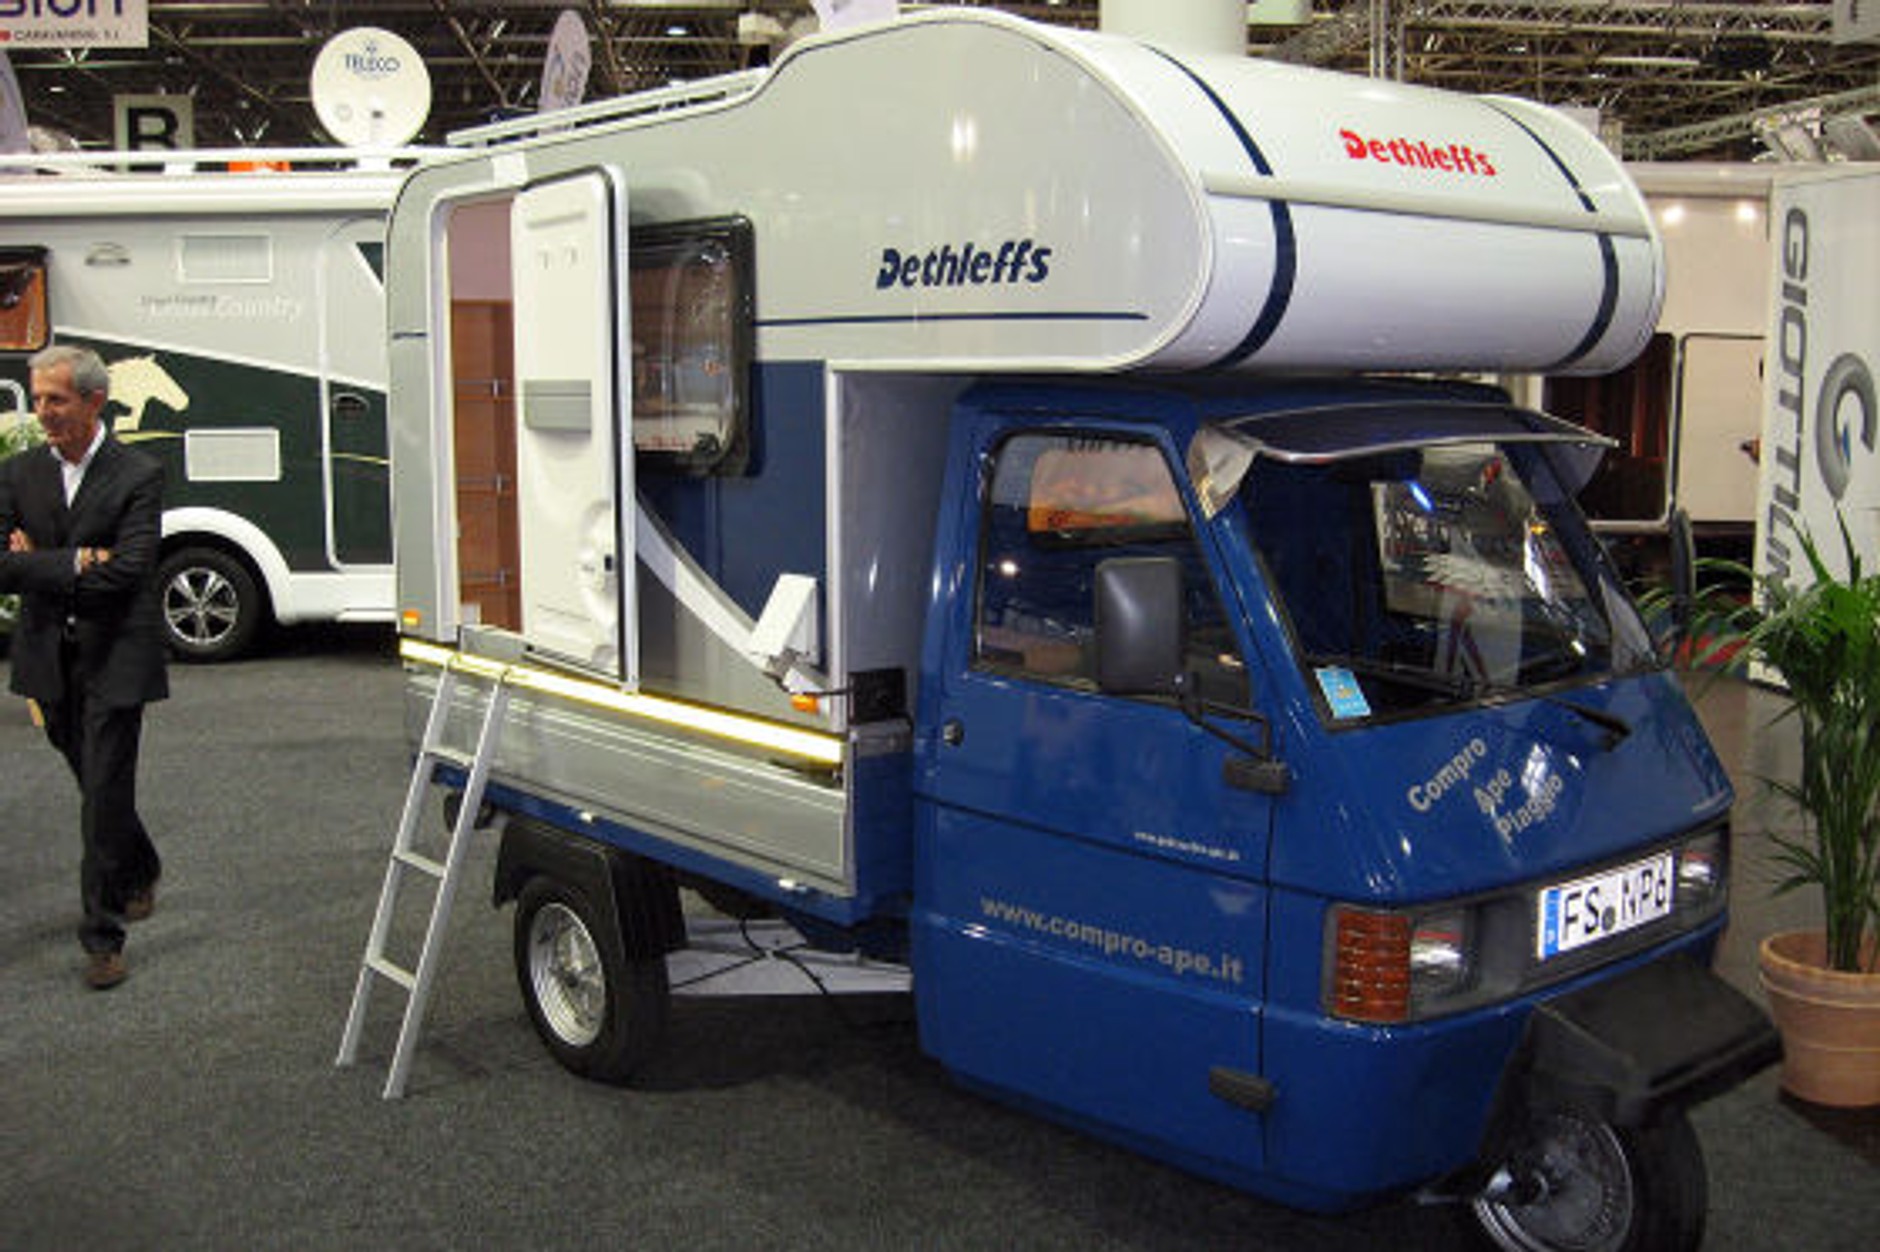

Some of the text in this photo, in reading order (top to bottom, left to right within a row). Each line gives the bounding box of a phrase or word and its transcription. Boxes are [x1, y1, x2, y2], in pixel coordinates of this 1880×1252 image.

[1339, 128, 1497, 176] Dethleffs
[876, 239, 1052, 289] Dethleffs
[1764, 207, 1808, 614] GIOTTILIN
[1407, 738, 1487, 812] Compro
[980, 896, 1243, 983] www.compro-ape.it
[1563, 886, 1599, 940] FS
